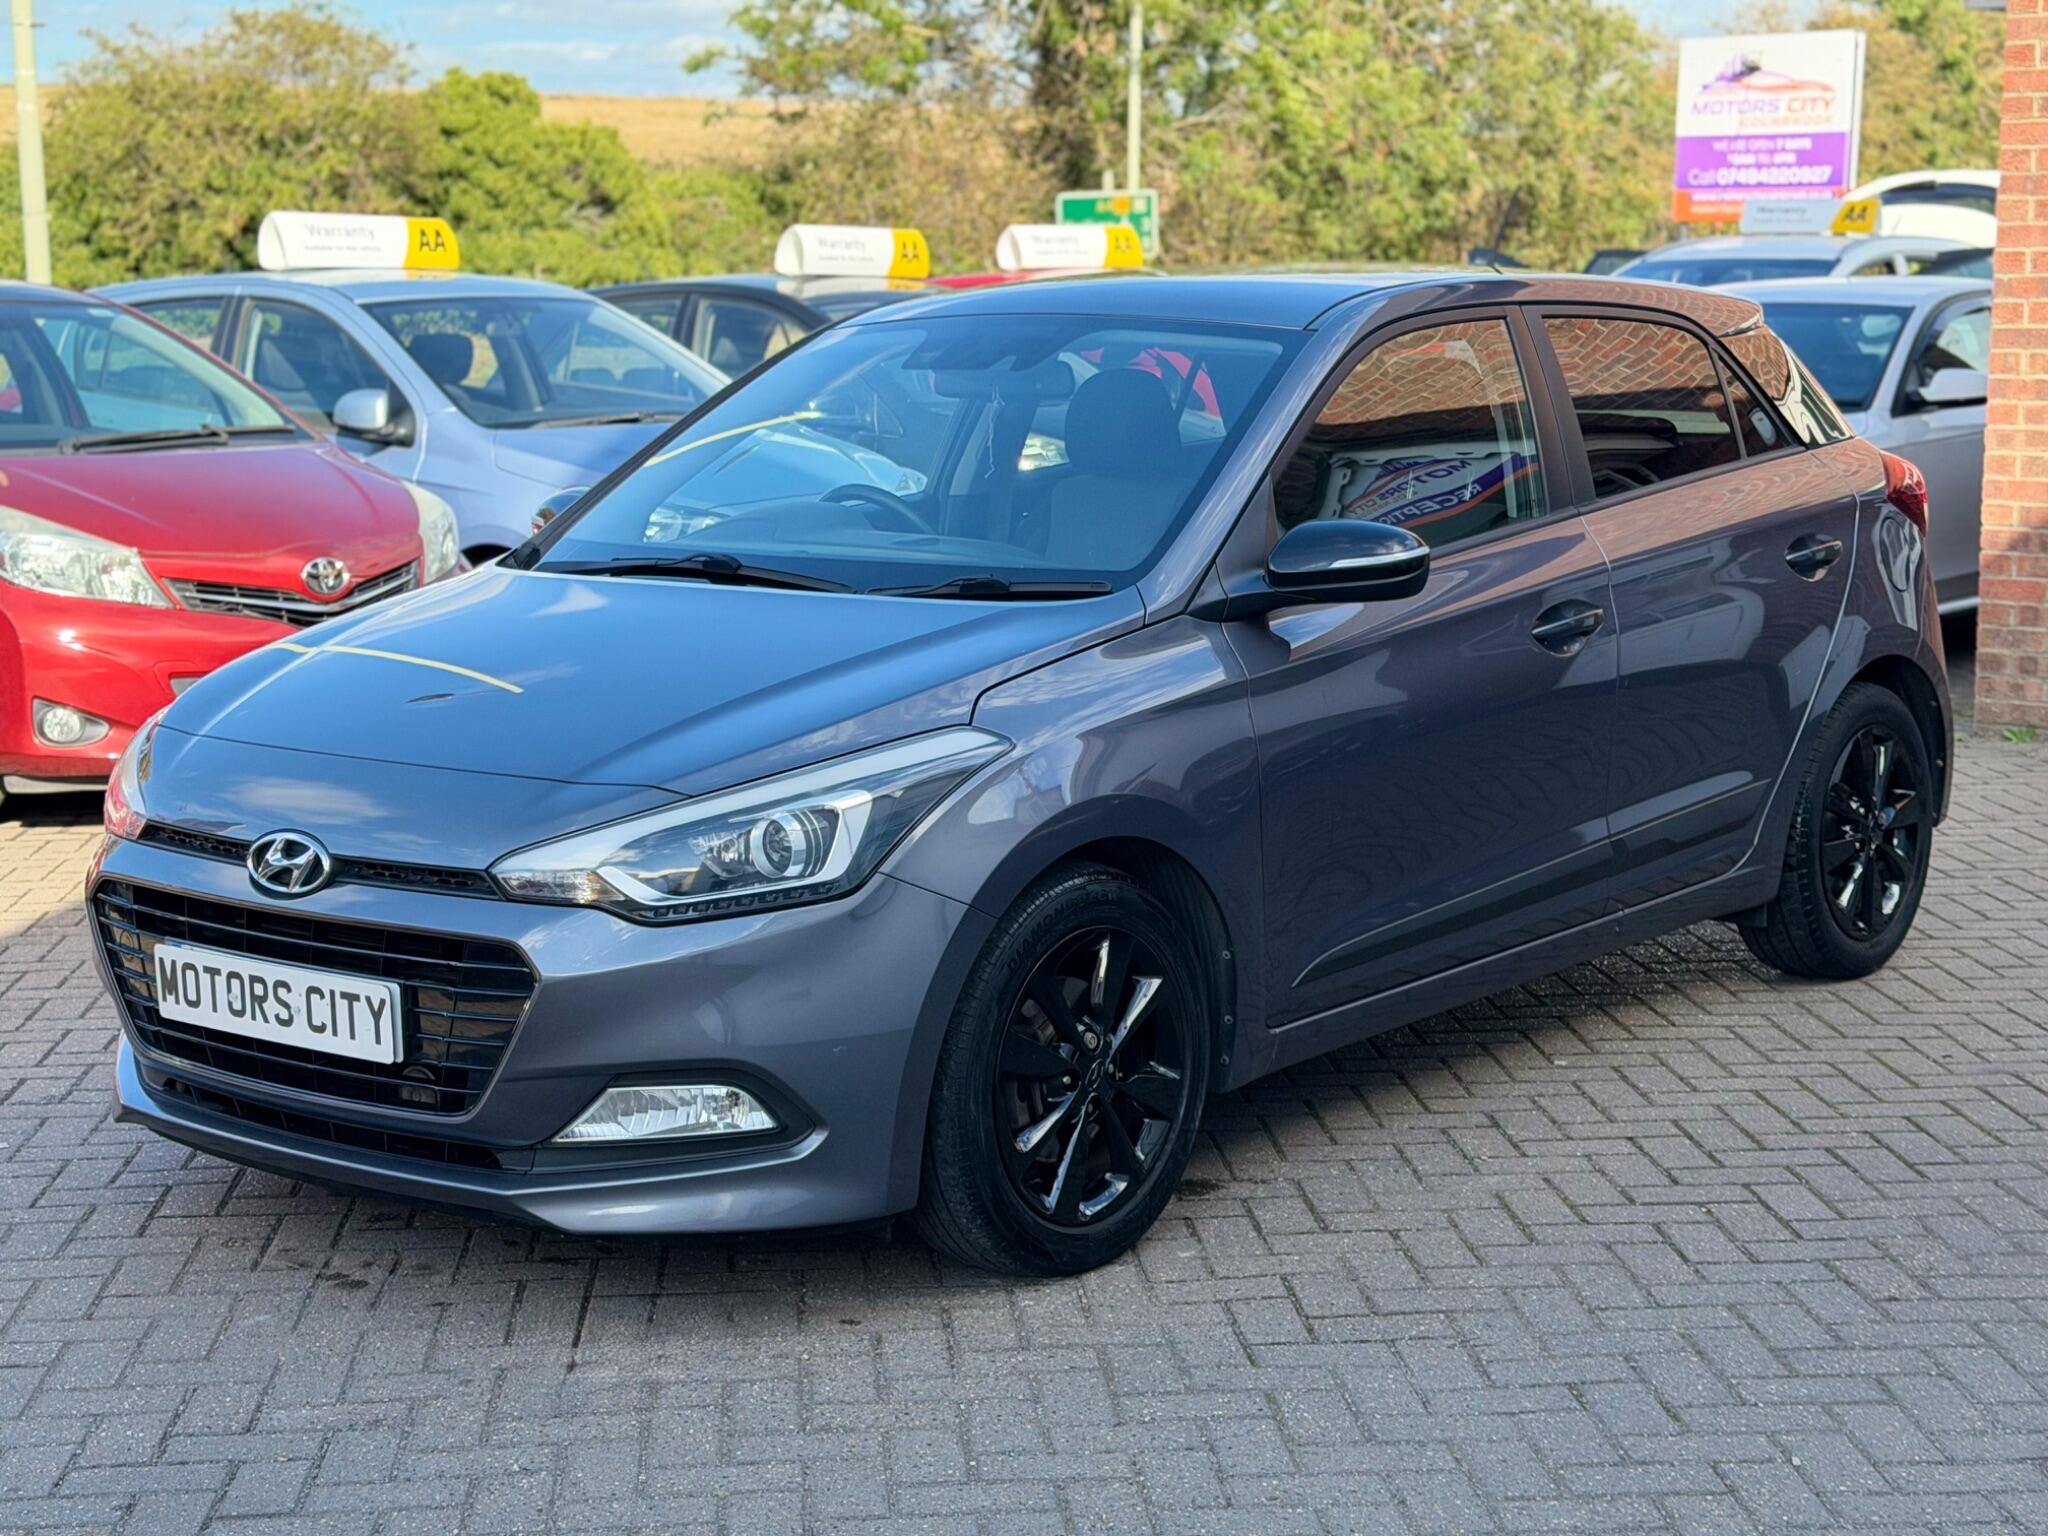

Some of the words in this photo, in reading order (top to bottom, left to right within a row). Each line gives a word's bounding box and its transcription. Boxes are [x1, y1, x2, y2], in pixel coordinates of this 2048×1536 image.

[1691, 98, 1781, 115] MOTORS
[1787, 97, 1836, 113] CITY
[1688, 167, 1716, 185] Call
[1842, 205, 1868, 221] AA
[304, 223, 375, 241] Warranty
[419, 228, 448, 252] AA
[817, 237, 866, 254] Warranty
[901, 240, 922, 263] AA
[1113, 233, 1134, 252] AA
[158, 956, 294, 1028] MOTORS
[305, 985, 387, 1046] CITY
